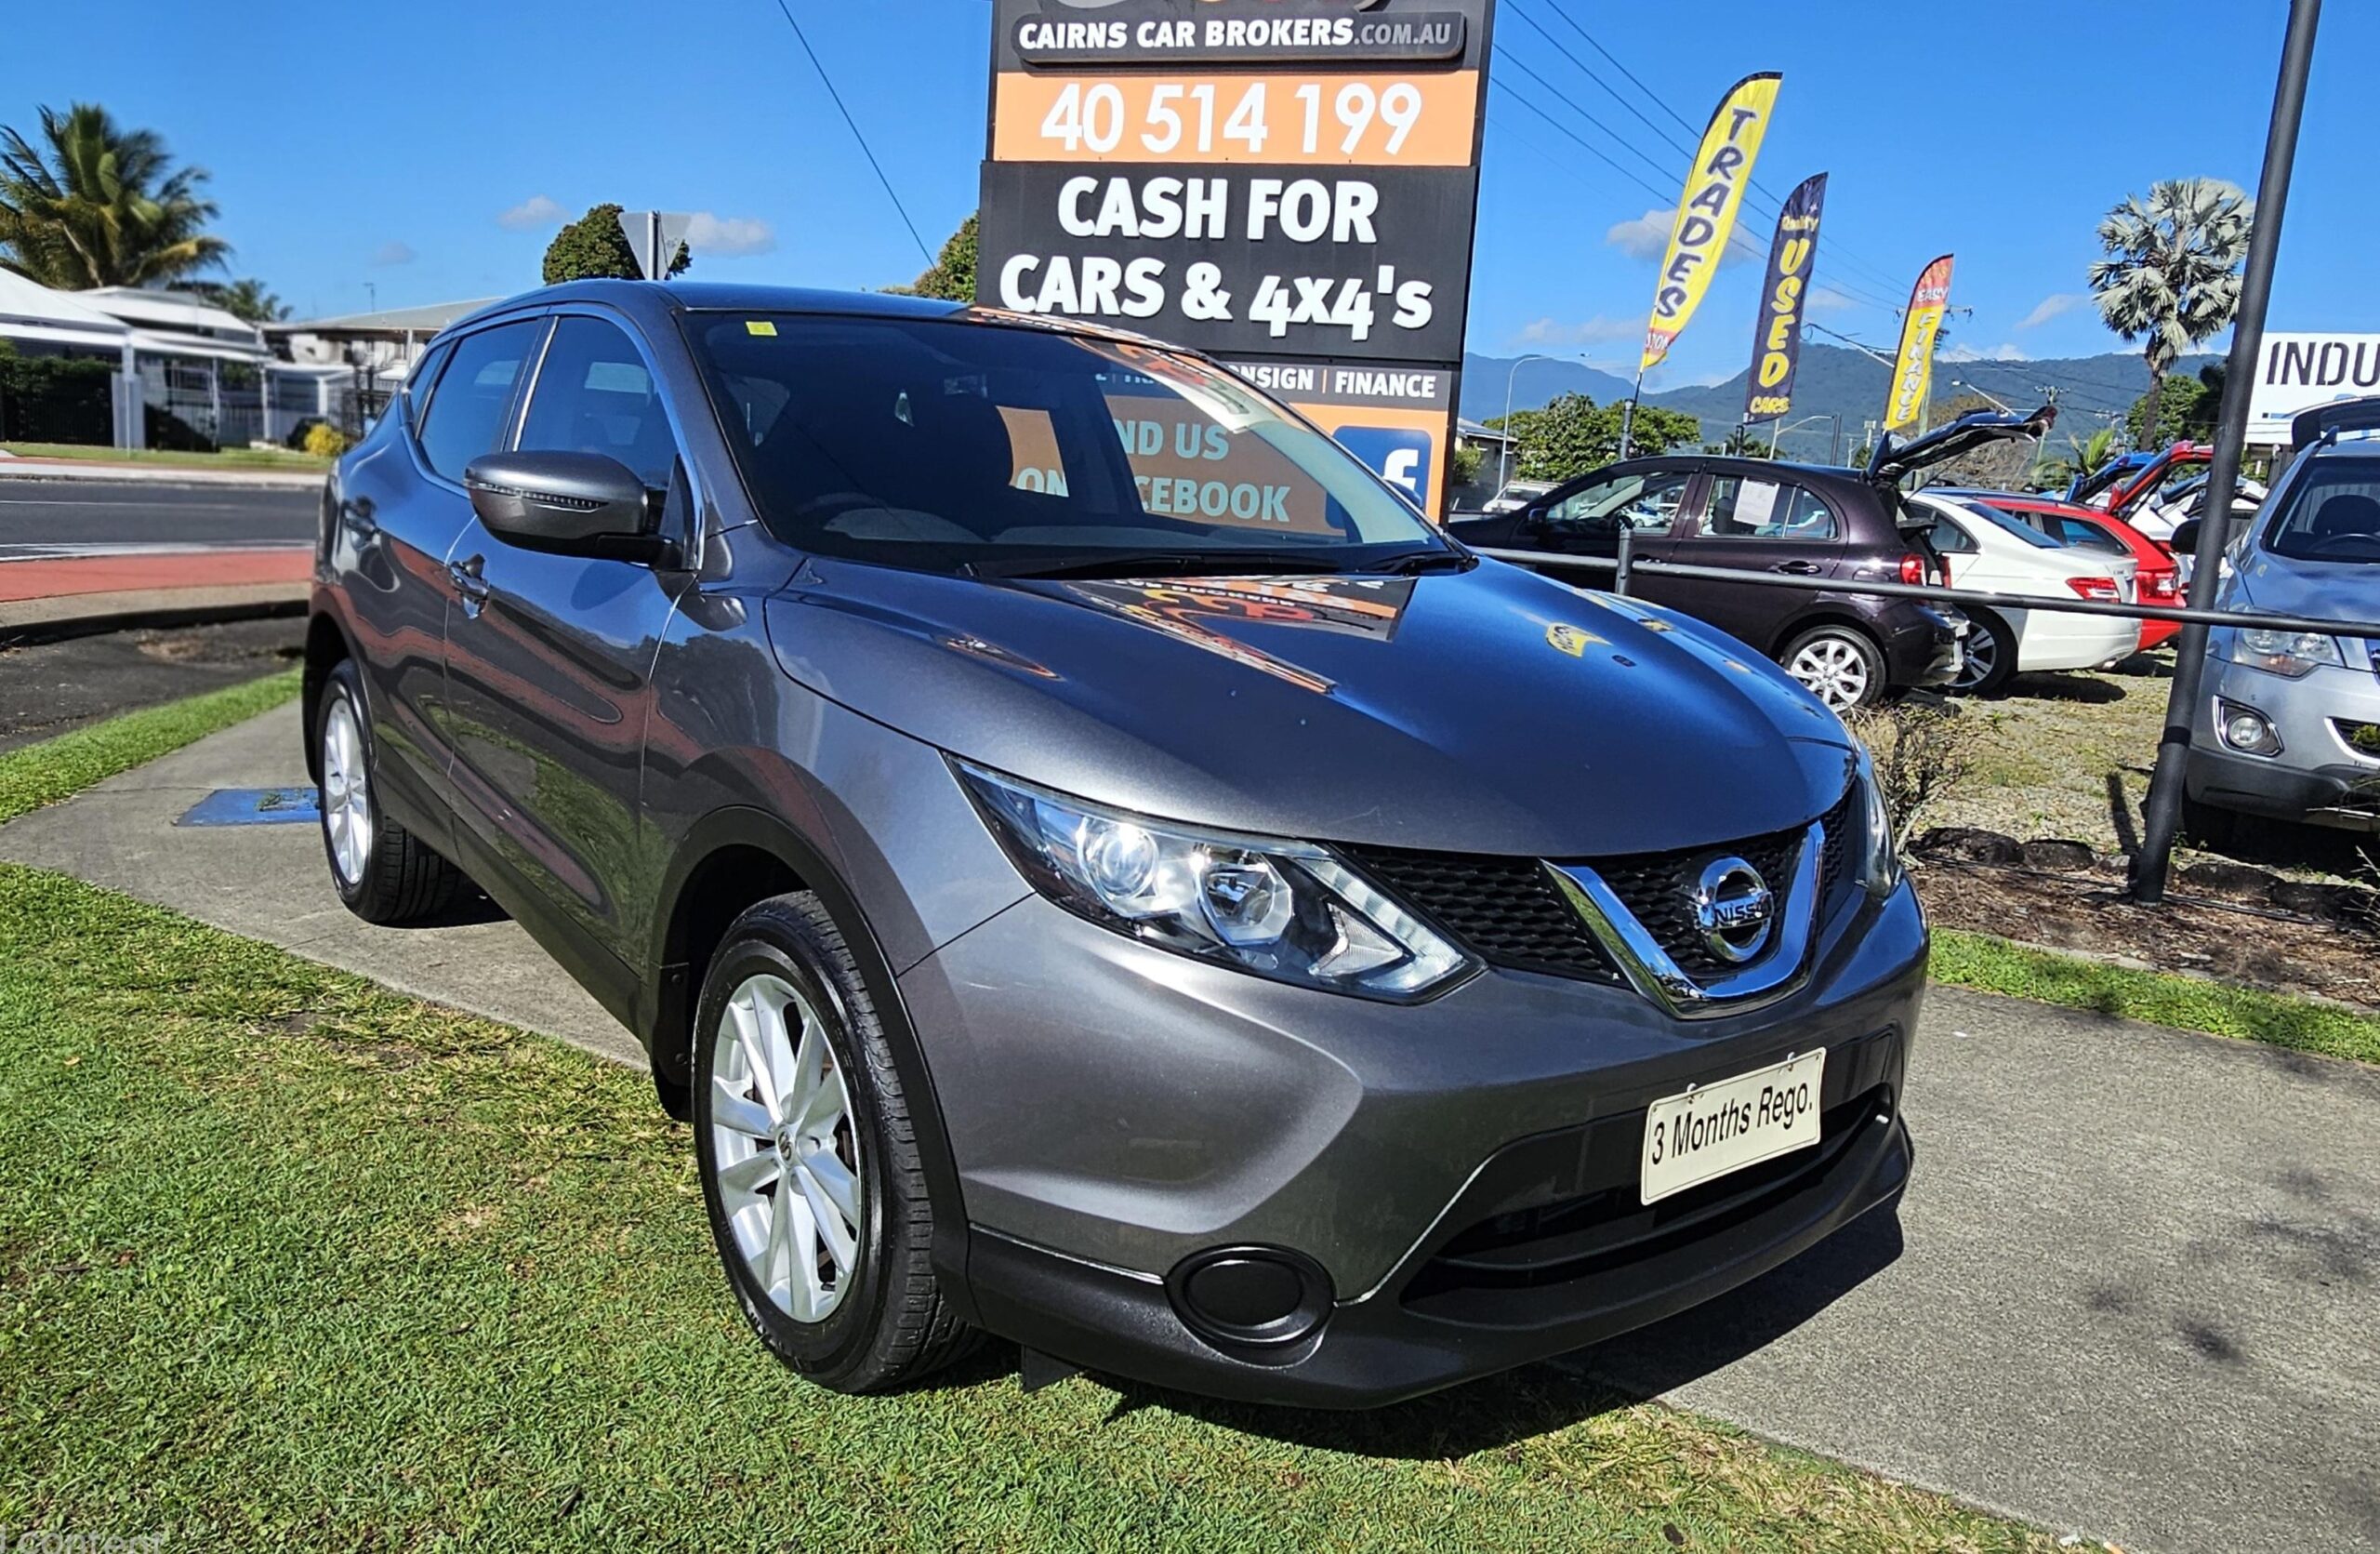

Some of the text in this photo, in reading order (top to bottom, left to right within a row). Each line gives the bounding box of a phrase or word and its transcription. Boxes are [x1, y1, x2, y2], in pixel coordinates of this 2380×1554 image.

[1019, 22, 1128, 49] CAIRNS
[1136, 21, 1196, 48] CAR
[1040, 82, 1422, 155] 40 514 199
[1058, 176, 1379, 244] CASH FOR
[1656, 108, 1757, 318] TRADES
[999, 254, 1166, 318] CARS
[1181, 261, 1233, 321] &
[1758, 238, 1811, 388] USED
[1228, 365, 1437, 399] NSIGN FINANCE
[1897, 312, 1936, 422] FINANCE
[1750, 396, 1791, 414] CARS
[1175, 423, 1229, 460] US
[1652, 1082, 1812, 1165] 3 Months Rego.
